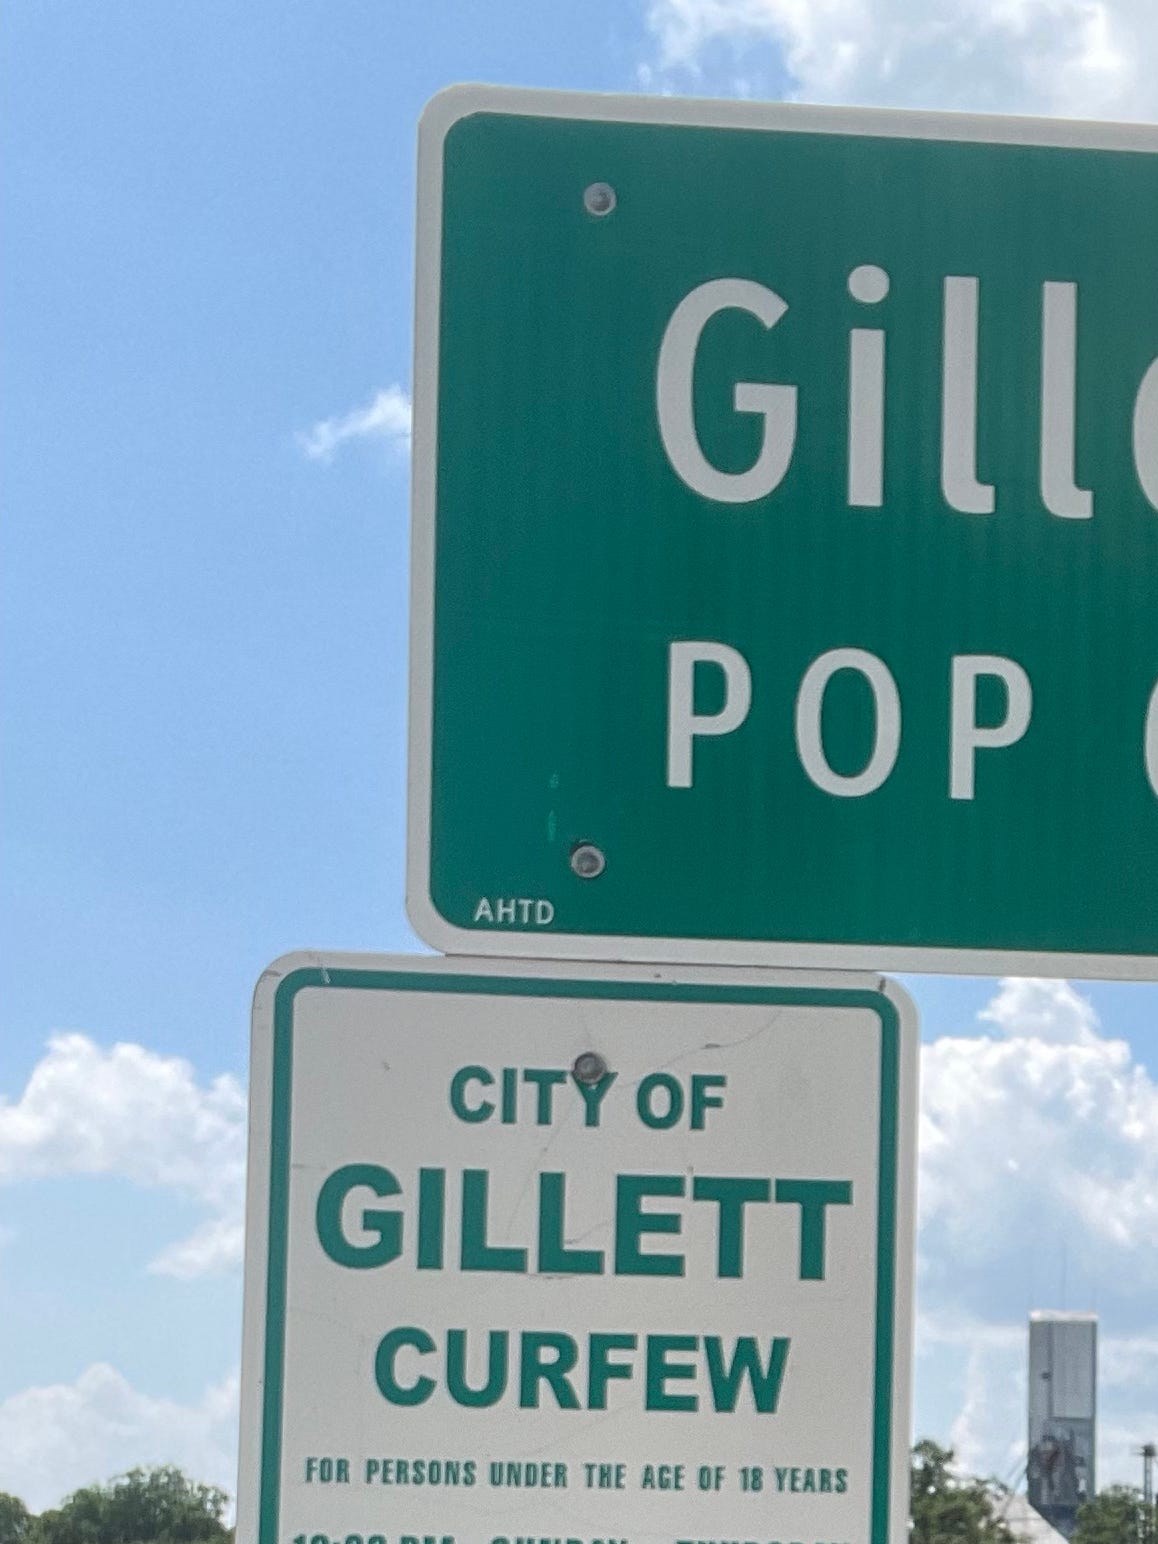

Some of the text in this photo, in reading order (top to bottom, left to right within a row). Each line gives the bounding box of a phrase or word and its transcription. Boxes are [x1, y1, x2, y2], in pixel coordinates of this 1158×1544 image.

[667, 640, 1033, 801] POP
[474, 897, 555, 924] AHTD
[450, 1065, 727, 1130] CITY OF
[315, 1163, 853, 1281] GILLETT
[374, 1326, 791, 1414] CURFEW
[306, 1458, 849, 1493] FOR PERSONS UNDER THE AGE OF 18 YEARS
